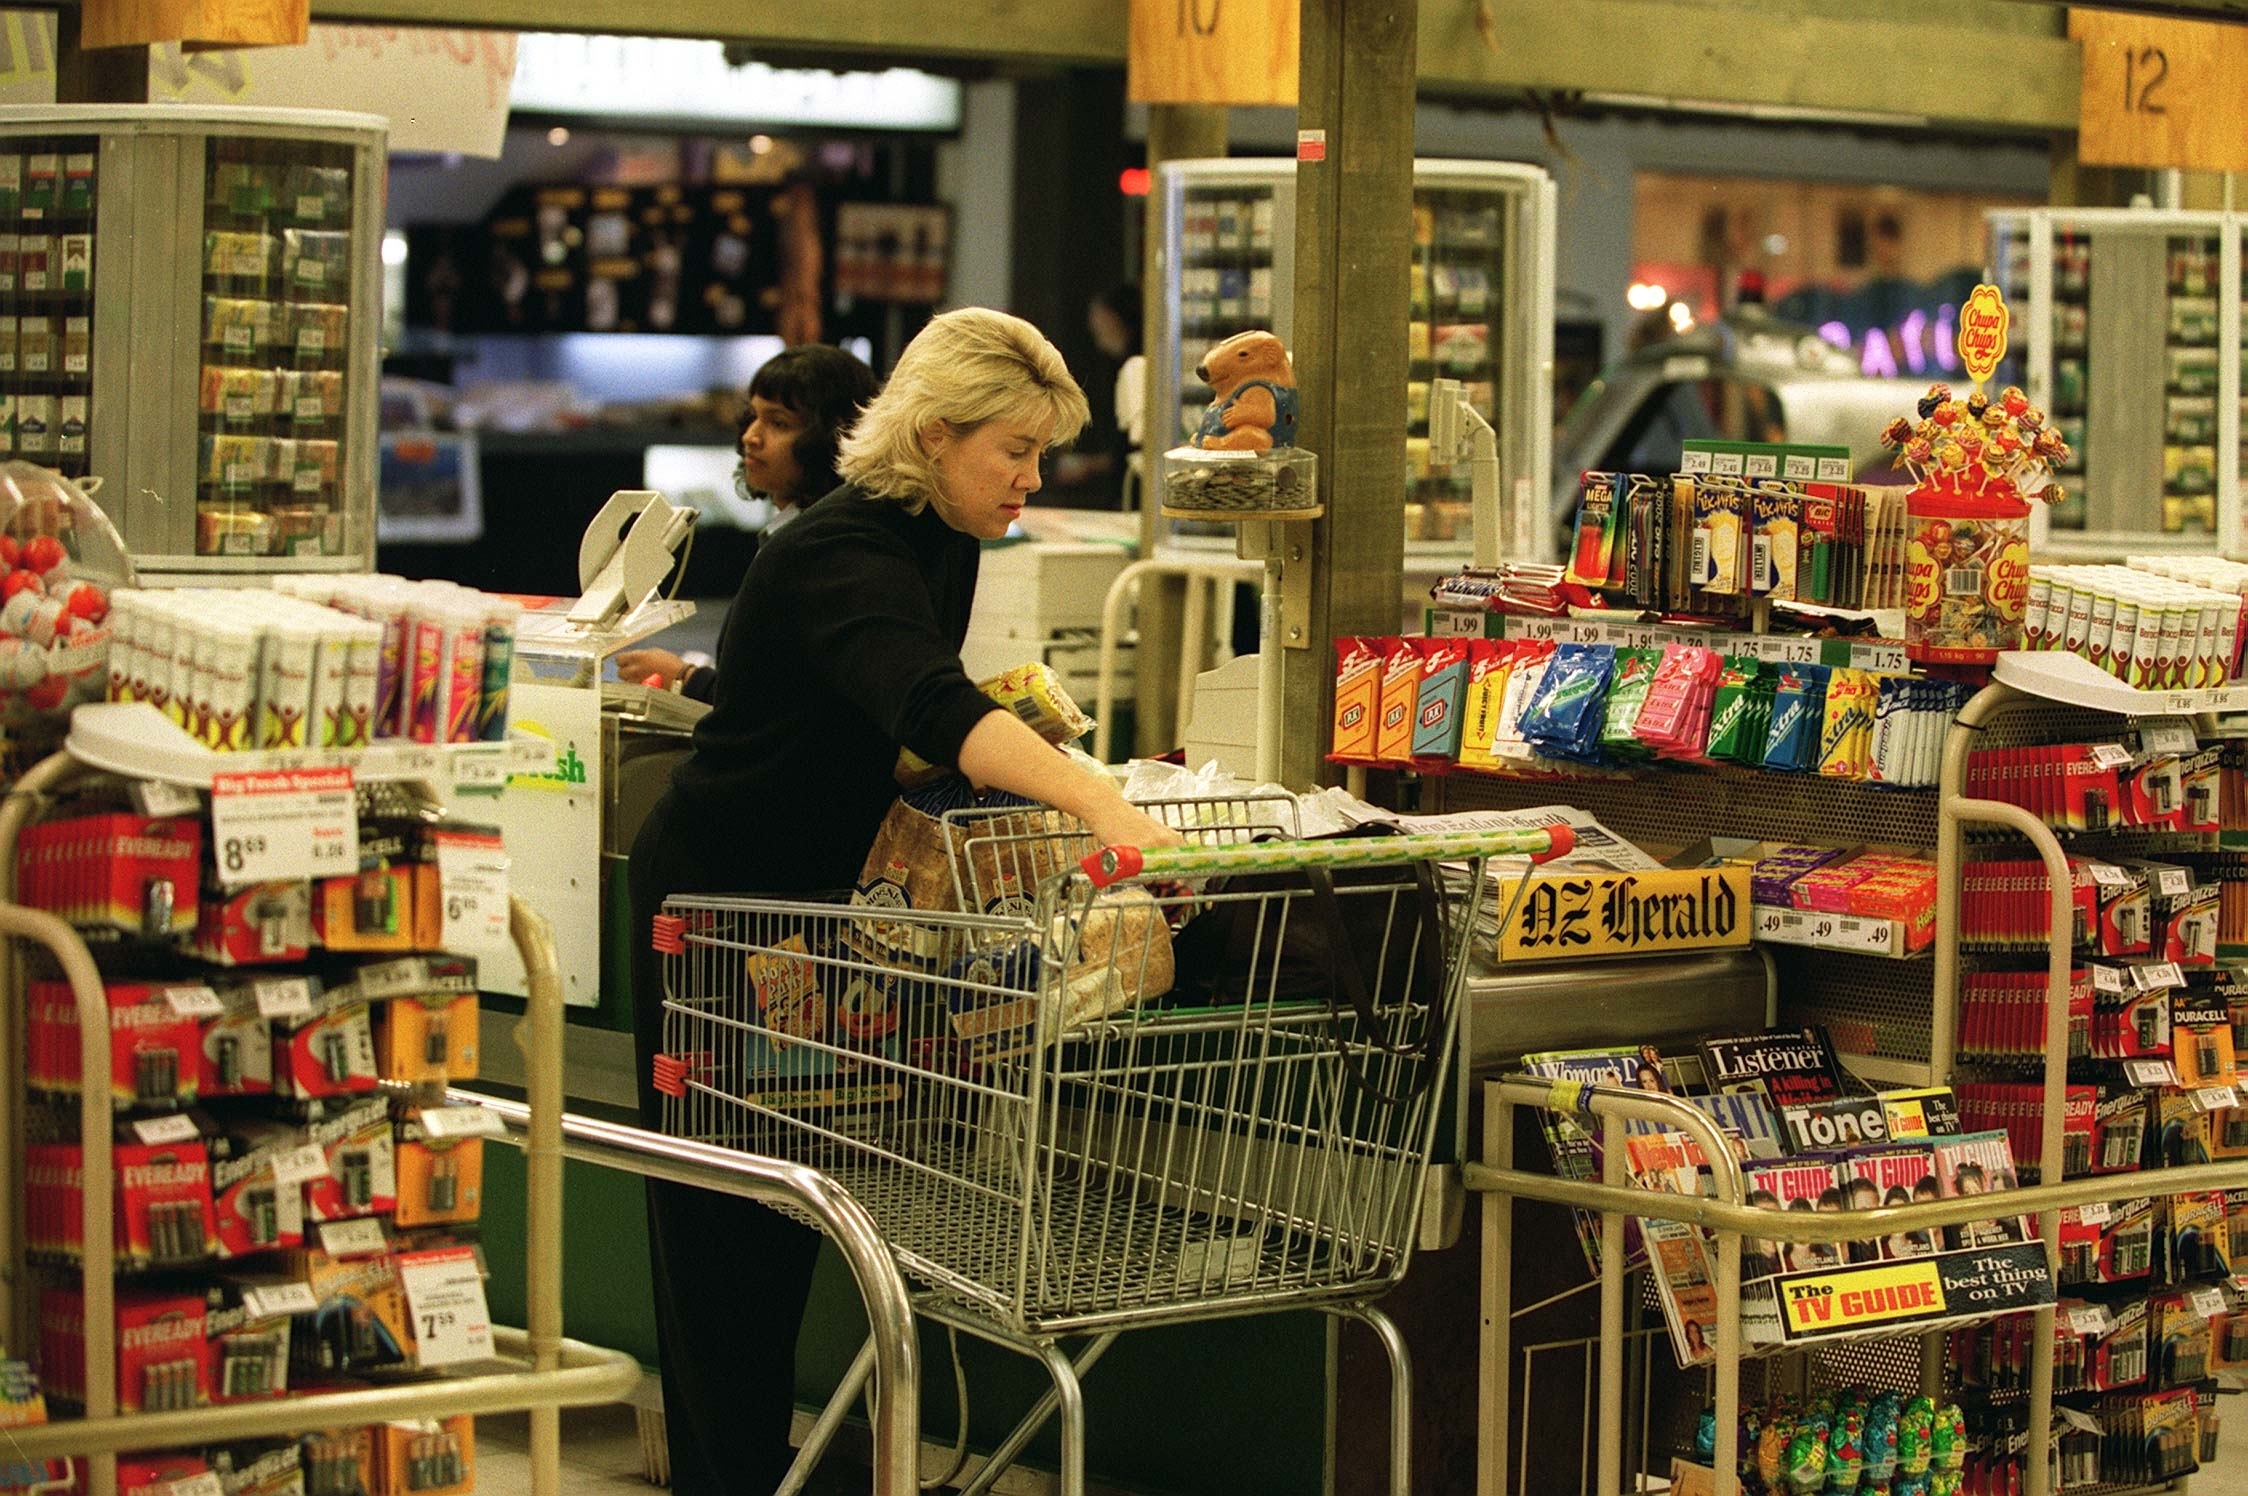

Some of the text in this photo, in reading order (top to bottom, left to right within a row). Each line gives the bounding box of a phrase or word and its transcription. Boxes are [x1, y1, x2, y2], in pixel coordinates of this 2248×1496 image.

[2124, 45, 2169, 115] 12
[1968, 308, 2000, 333] Chupa
[1965, 328, 1998, 354] Chups
[1586, 489, 1613, 503] MEGA
[1997, 560, 2029, 584] Chup
[1453, 617, 1478, 633] 1.99
[1526, 623, 1552, 639] 1.99
[1573, 626, 1599, 642] 1.99
[1732, 641, 1759, 658] 1.75
[1785, 645, 1813, 662] 1.75
[1874, 653, 1902, 669] 1.75
[1520, 874, 1736, 948] NZ Herald
[1759, 915, 1780, 932] .49
[1810, 921, 1832, 937] .49
[1867, 927, 1888, 943] .49
[2174, 998, 2186, 1009] AA
[2174, 1008, 2228, 1023] DURACELL
[1709, 1045, 1824, 1077] Listener
[1771, 1074, 1832, 1093] A killing in
[1786, 1108, 1885, 1147] Tone
[1899, 1115, 1925, 1131] GUIDE
[1940, 1139, 2011, 1176] TV GUIDE
[1854, 1155, 1931, 1190] TV GUIDE
[1754, 1166, 1834, 1202] TV GUIDE
[1972, 1256, 2013, 1273] The
[1944, 1266, 2047, 1291] best thing
[1789, 1284, 1834, 1300] The
[1968, 1280, 2030, 1302] on TV
[1792, 1281, 1938, 1324] TV GUIDE
